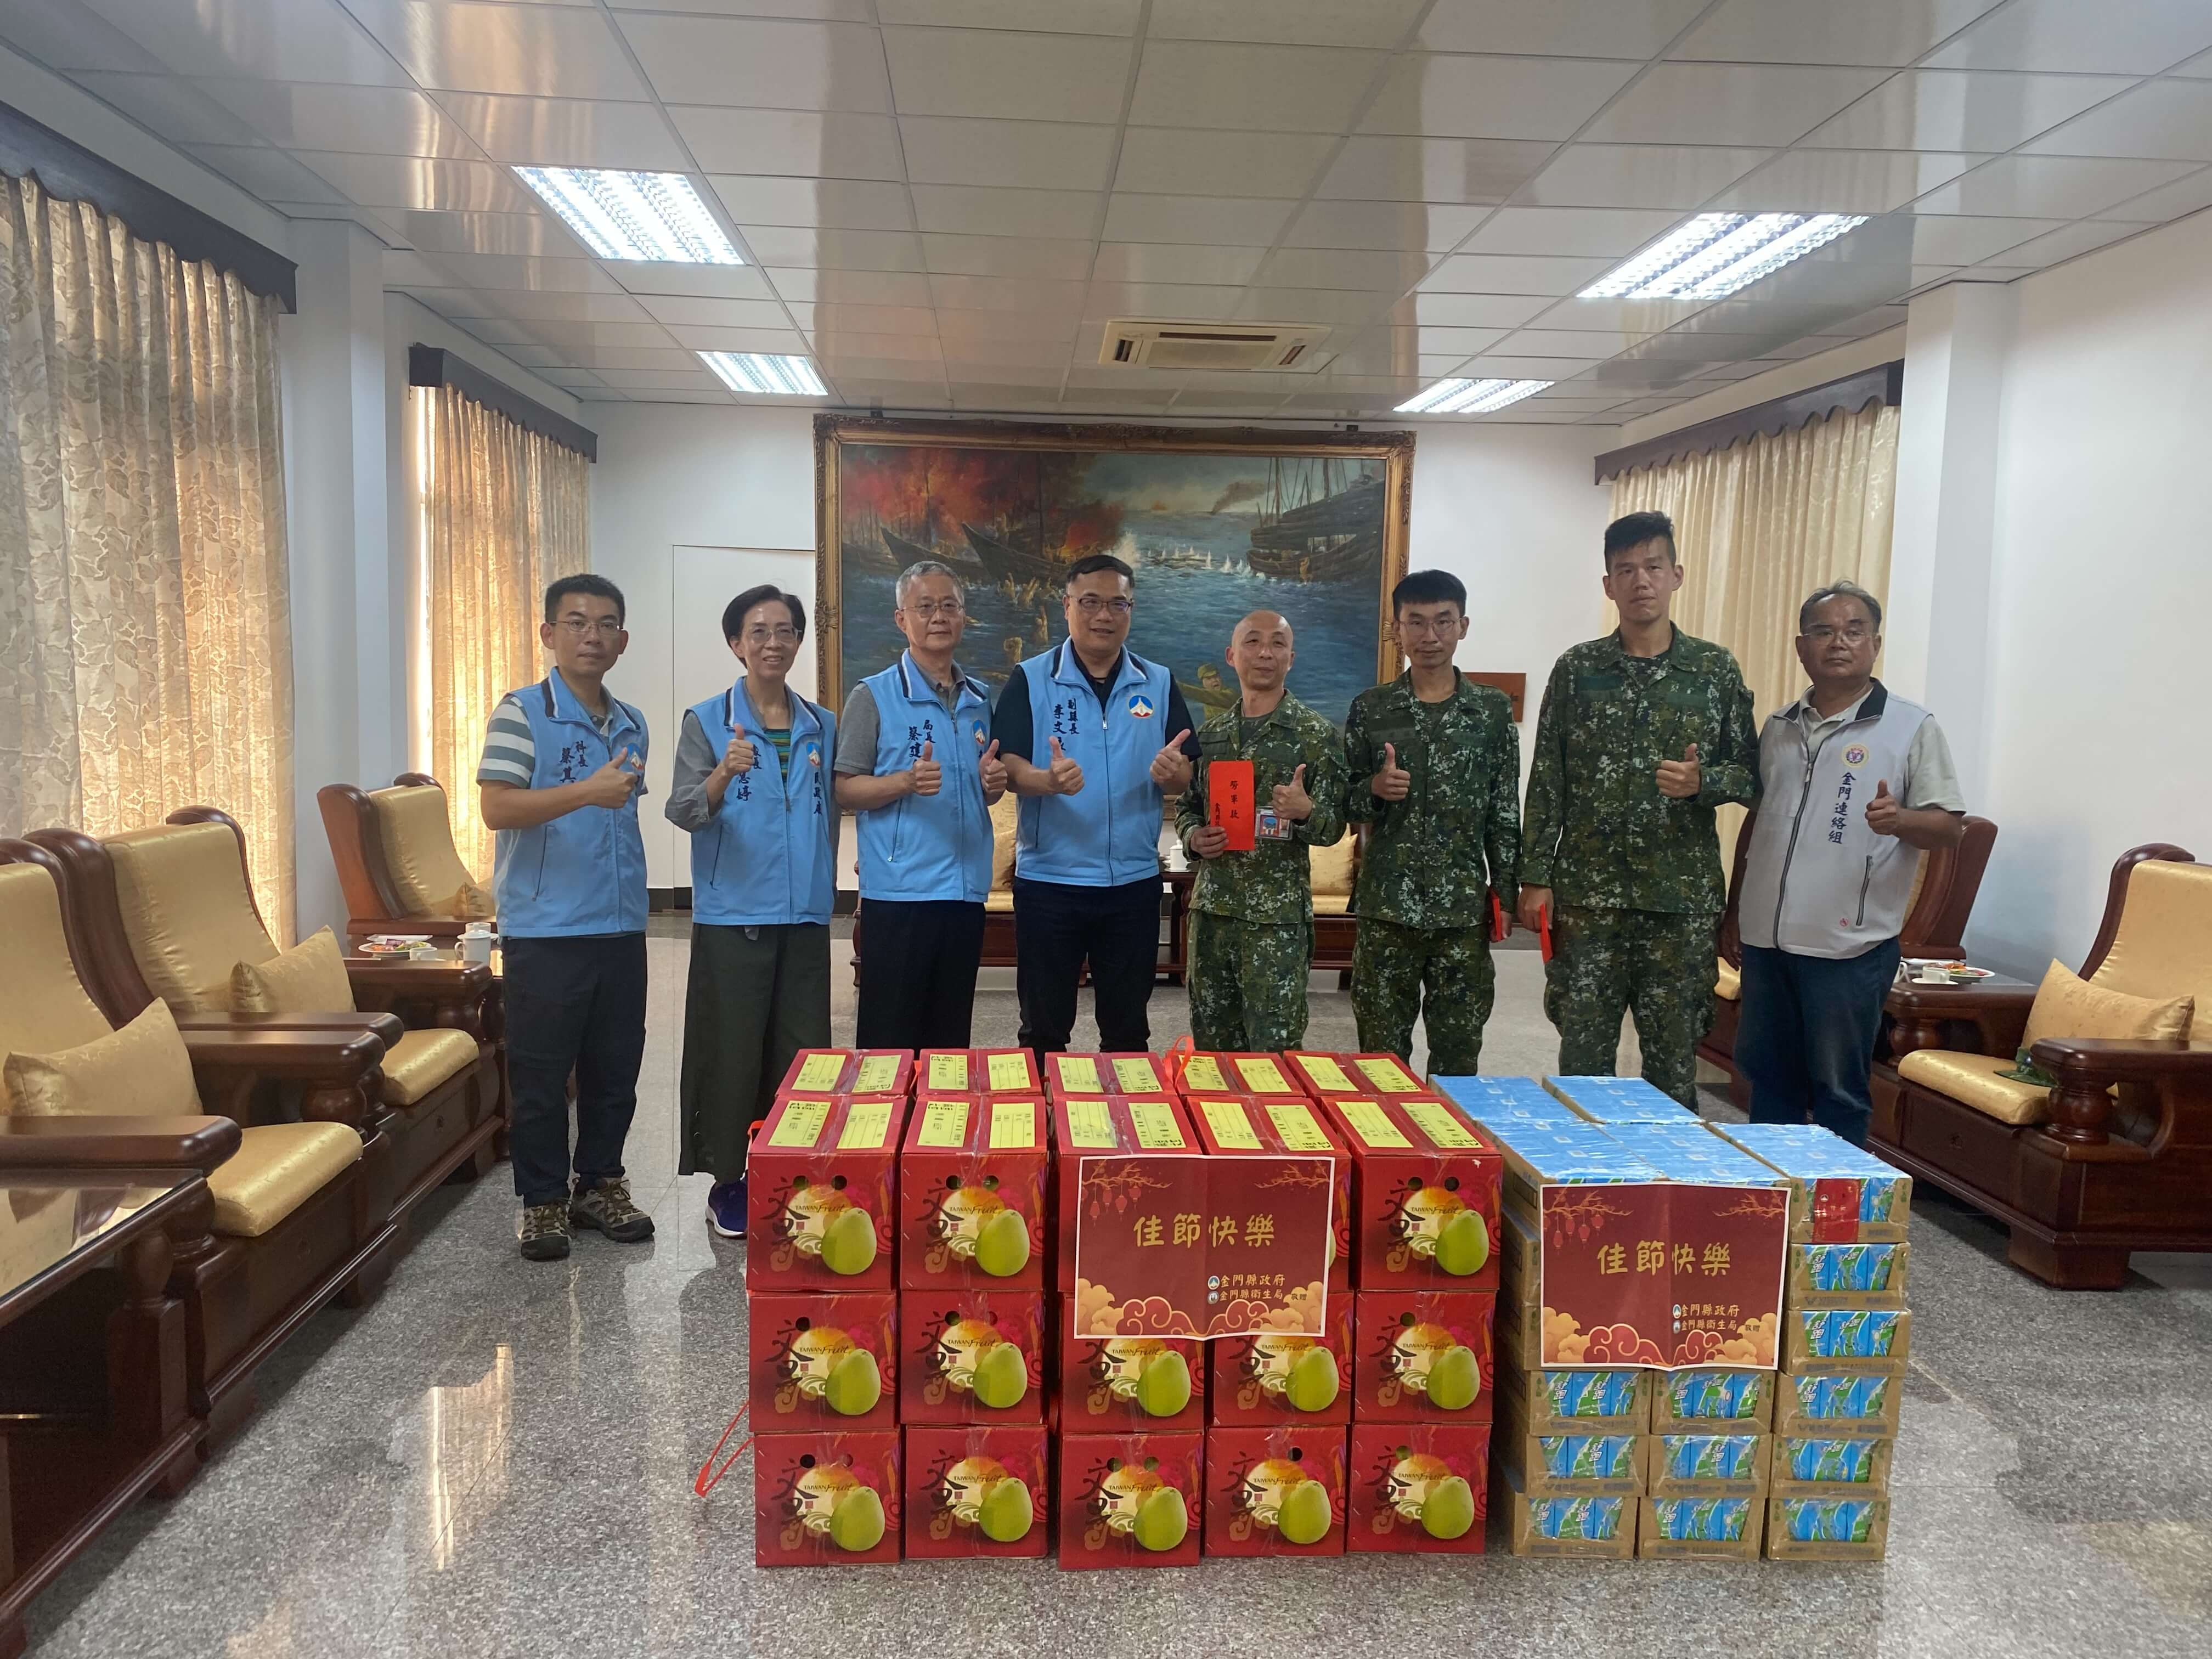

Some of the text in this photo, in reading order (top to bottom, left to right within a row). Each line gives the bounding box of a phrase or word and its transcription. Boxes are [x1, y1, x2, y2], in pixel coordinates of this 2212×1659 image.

[923, 719, 936, 744] 局長
[908, 726, 922, 765] 蔡建
[576, 741, 589, 767] 科長
[1829, 772, 1857, 844] 金門連絡組
[816, 1204, 846, 1214] Fruit
[970, 1205, 998, 1215] Fruit
[1431, 1206, 1459, 1214] Fruit
[1133, 1212, 1275, 1249] 佳節快樂
[1597, 1239, 1730, 1277] 佳節快樂
[1220, 1273, 1286, 1288] 金門縣政府
[1219, 1289, 1283, 1301] 金門縣衛生局
[1681, 1303, 1740, 1317] 金門縣政府
[1680, 1319, 1737, 1331] 金門縣衛生局
[968, 1338, 996, 1347] Fruit
[1422, 1342, 1450, 1351] Fruit
[821, 1345, 849, 1355] Fruit
[1132, 1347, 1160, 1357] Fruit
[1282, 1344, 1310, 1352] Fruit
[974, 1475, 1002, 1484] Fruit
[1273, 1477, 1301, 1486] Fruit
[1418, 1472, 1444, 1481] Fruit
[825, 1483, 853, 1493] Fruit
[1130, 1483, 1158, 1493] Fruit
